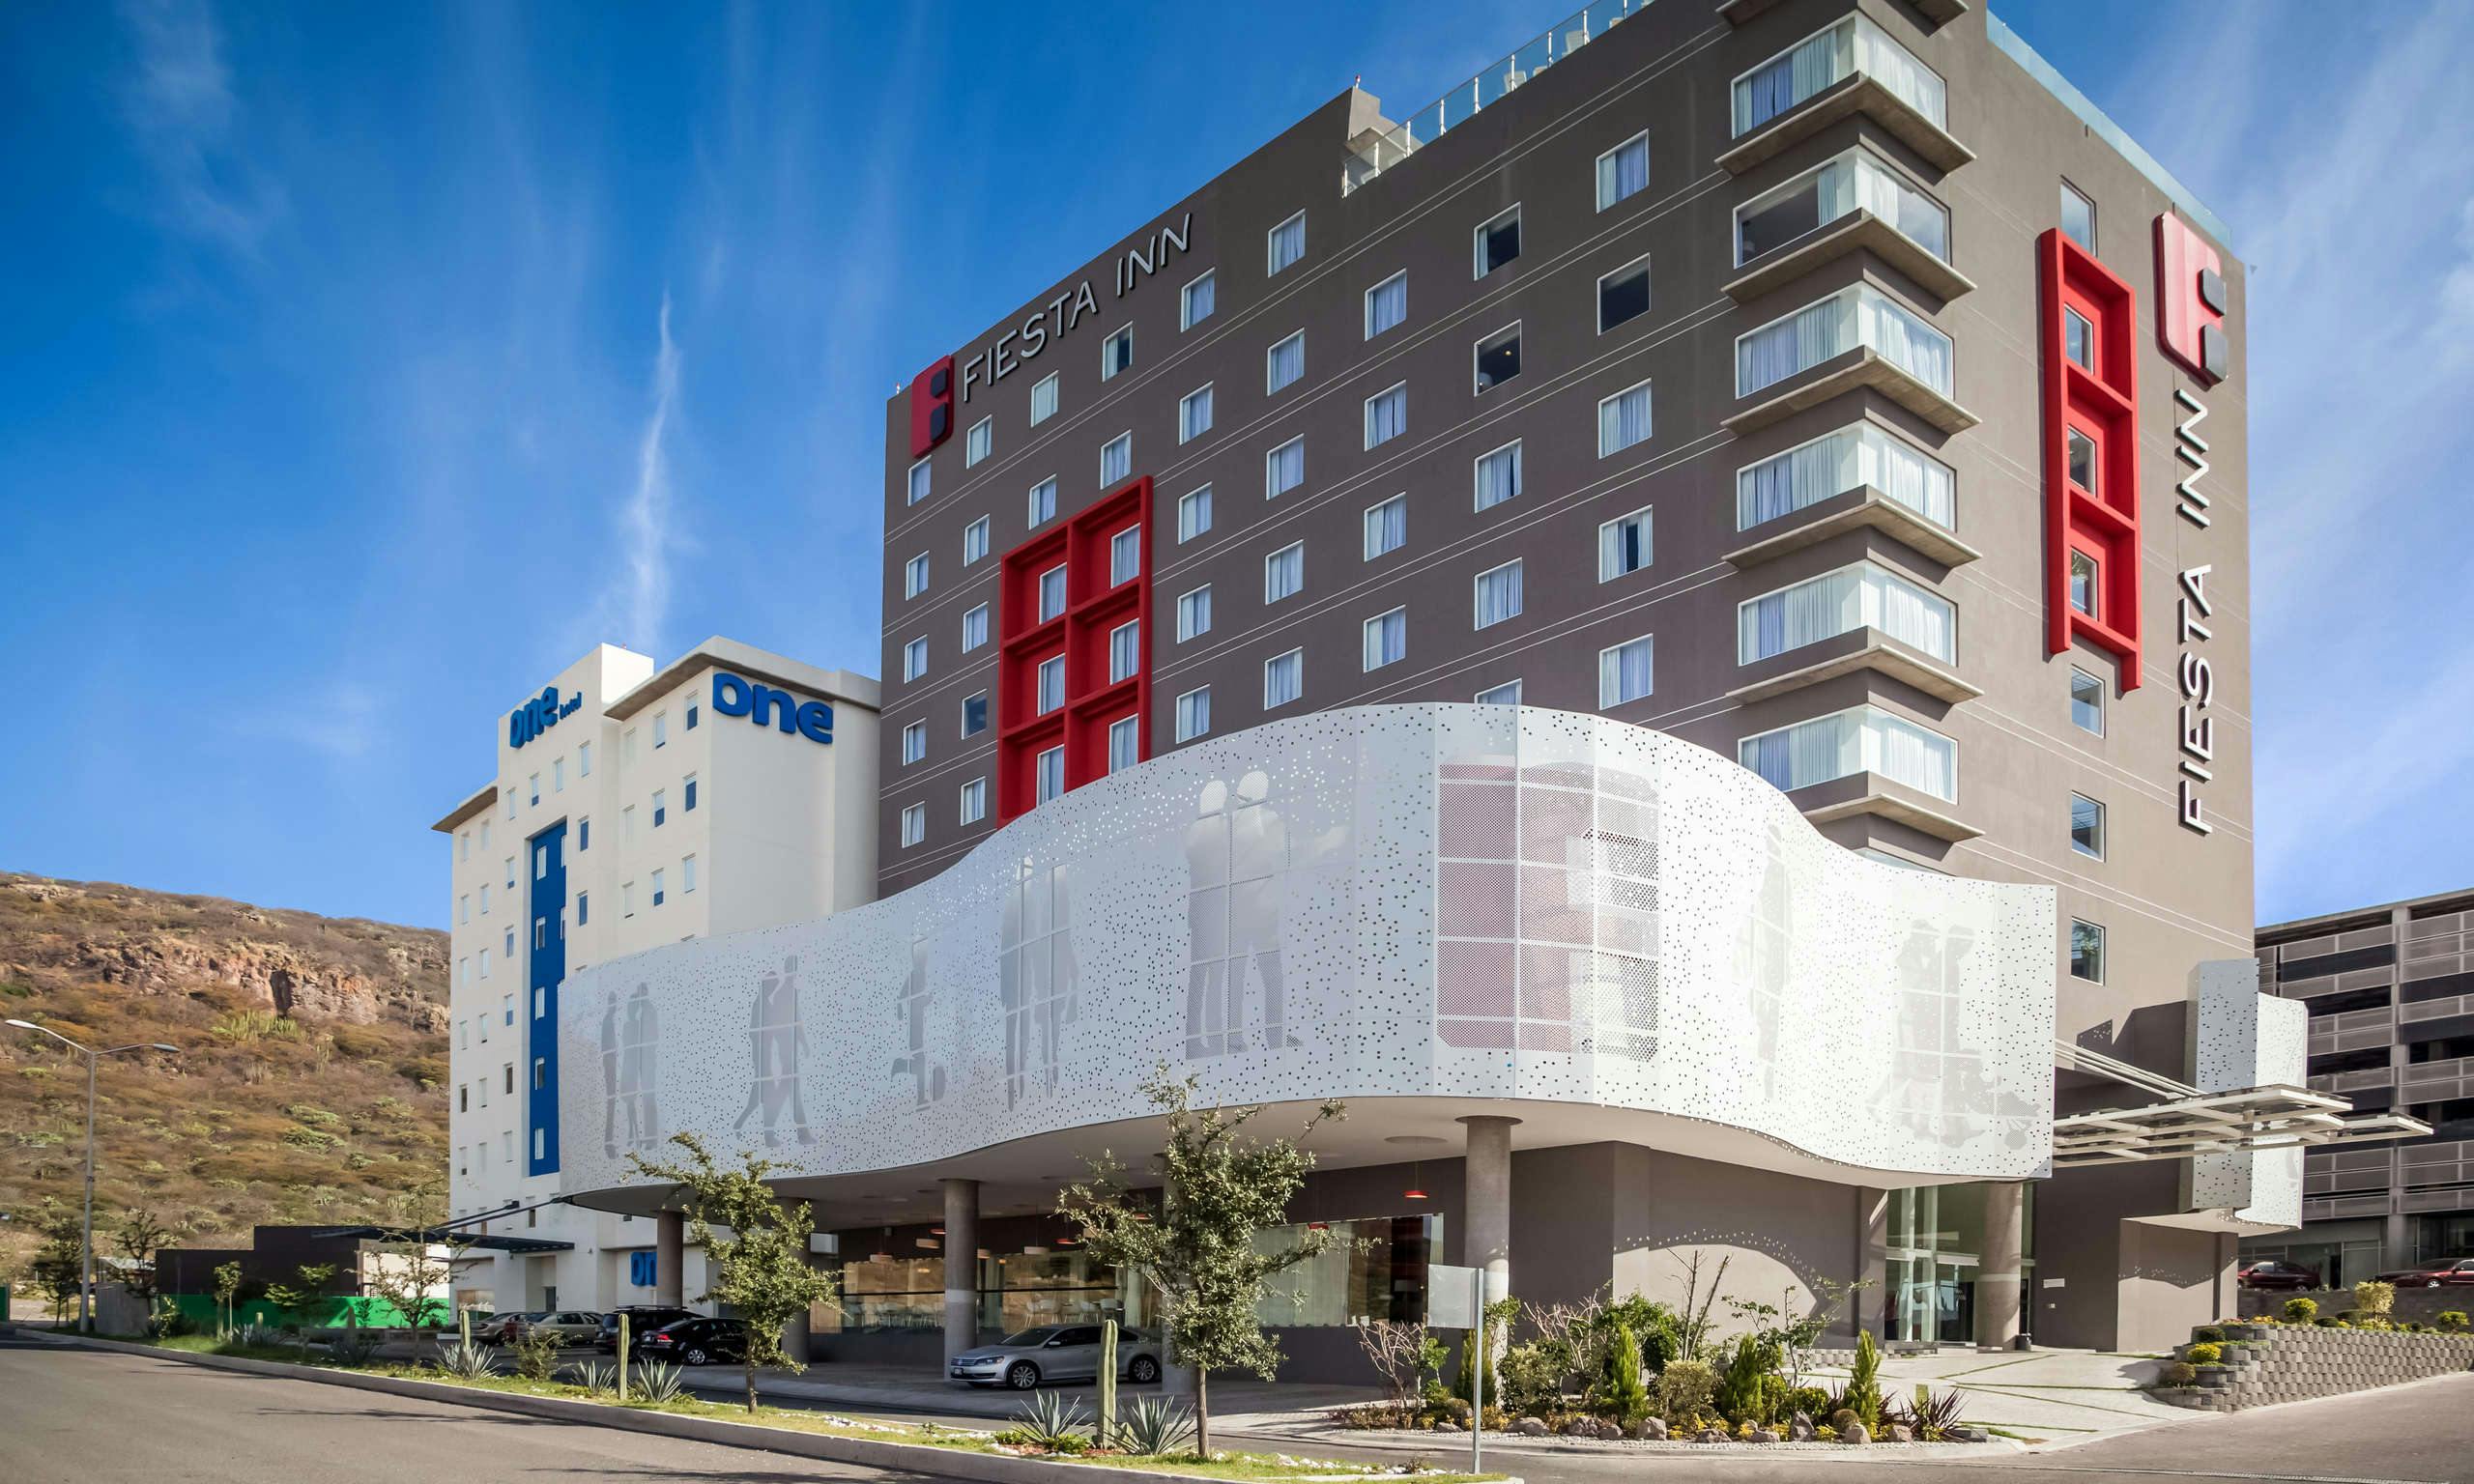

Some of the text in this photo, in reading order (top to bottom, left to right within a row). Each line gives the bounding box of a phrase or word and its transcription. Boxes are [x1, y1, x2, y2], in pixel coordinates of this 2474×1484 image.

[963, 213, 1193, 403] FIESTA INN
[2174, 388, 2213, 838] FIESTA INN
[510, 687, 559, 750] one
[712, 672, 834, 745] one
[630, 1251, 658, 1287] on
